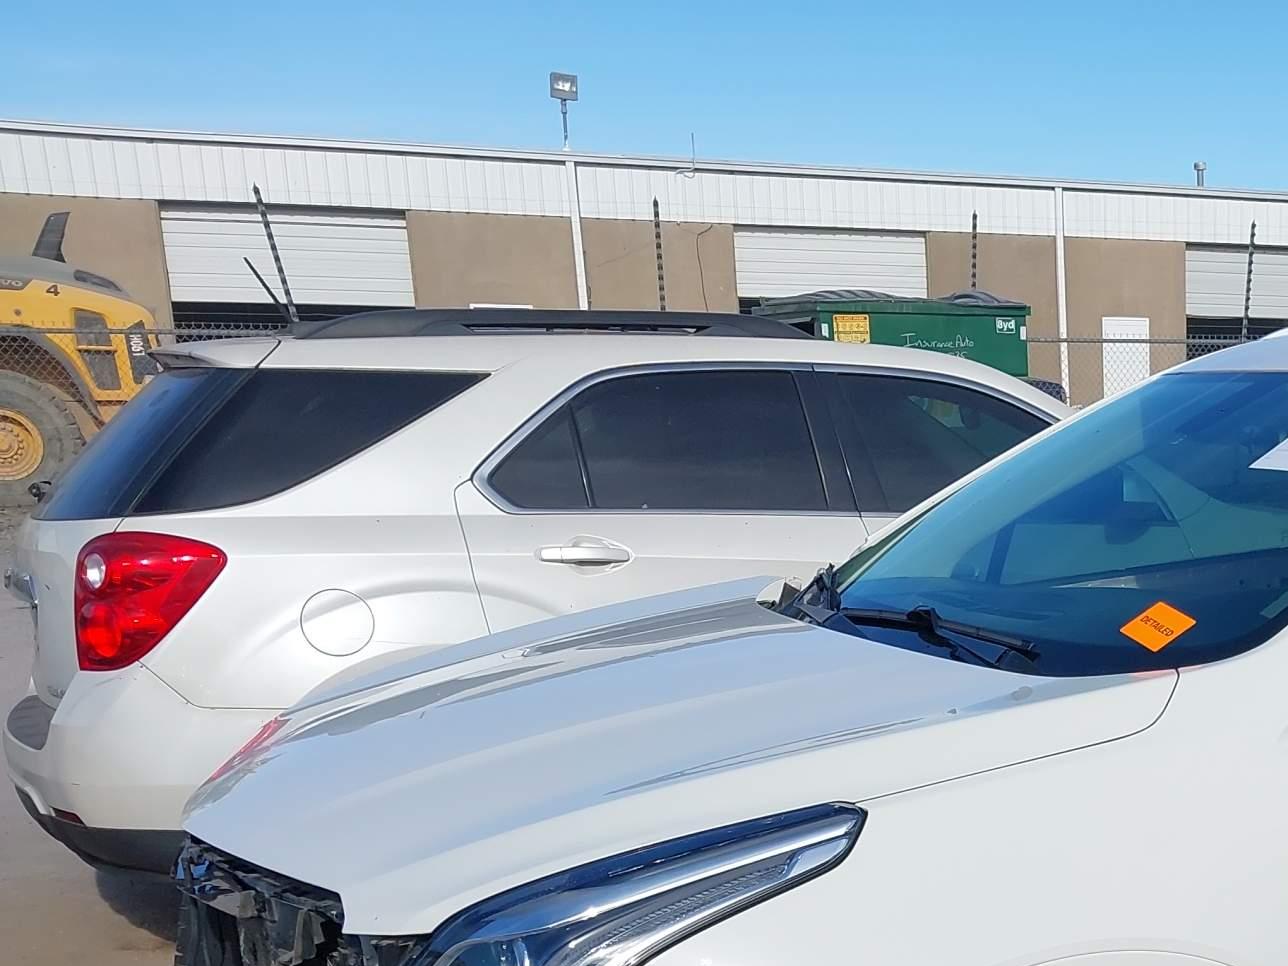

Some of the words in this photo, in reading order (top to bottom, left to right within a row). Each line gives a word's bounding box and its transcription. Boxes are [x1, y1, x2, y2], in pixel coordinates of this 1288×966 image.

[46, 284, 60, 296] 4
[128, 334, 145, 356] L90H
[899, 332, 955, 348] Insurance
[955, 333, 975, 348] Auto
[1140, 616, 1174, 636] DETAILED
